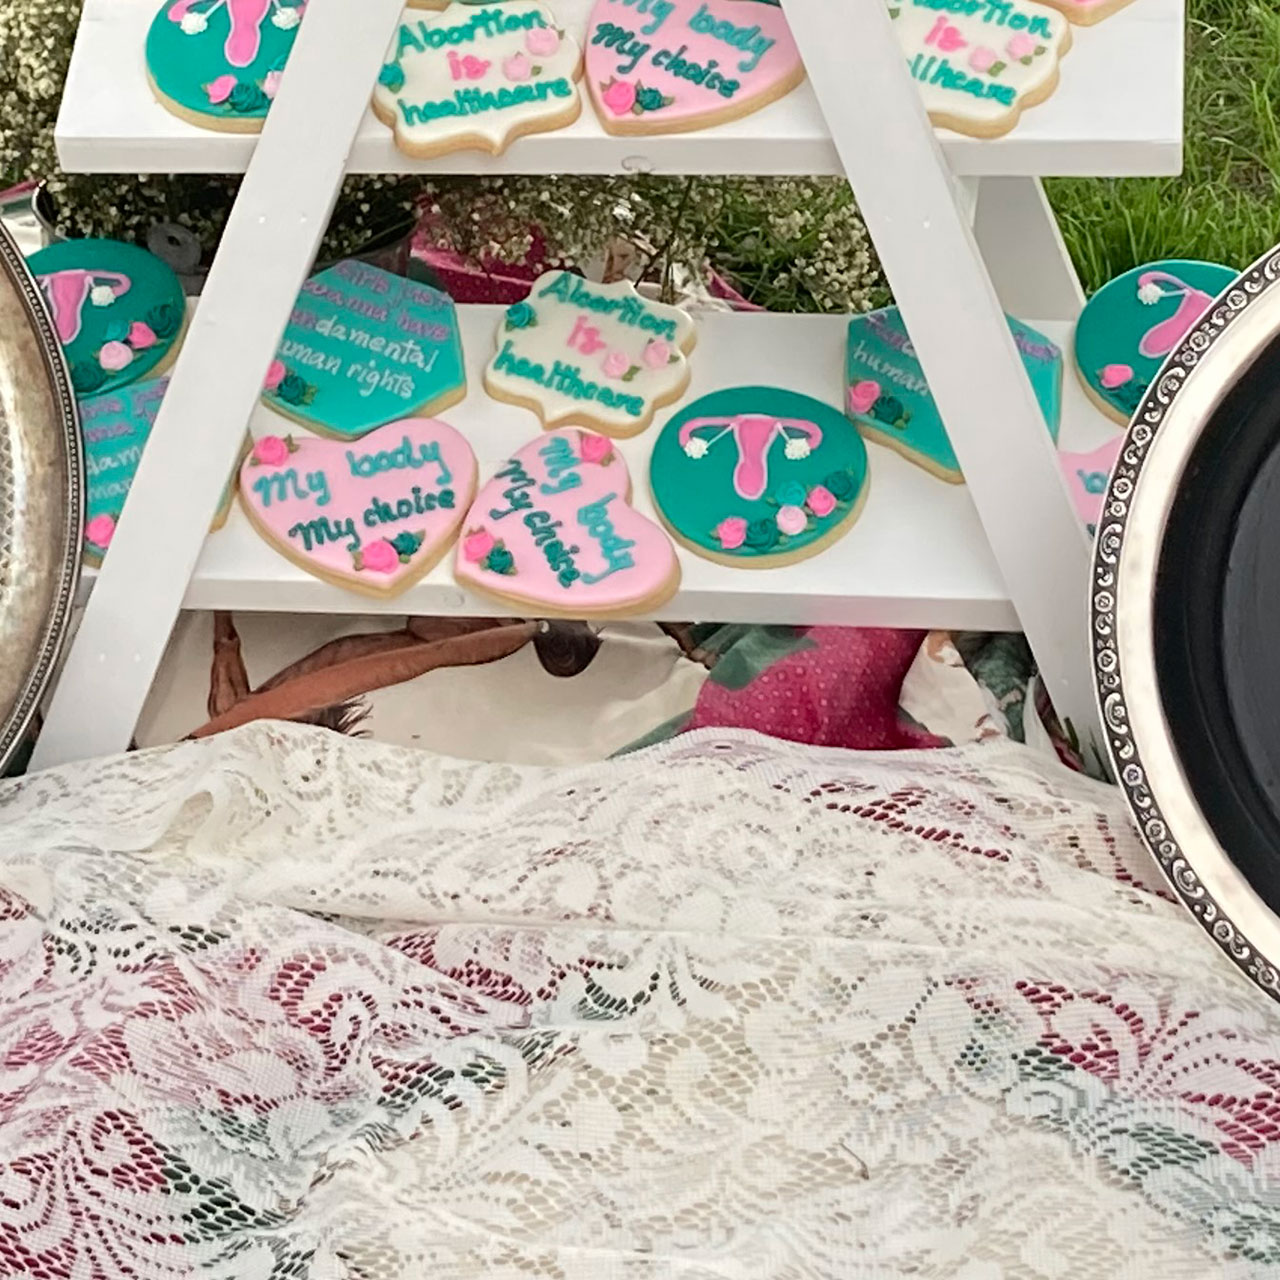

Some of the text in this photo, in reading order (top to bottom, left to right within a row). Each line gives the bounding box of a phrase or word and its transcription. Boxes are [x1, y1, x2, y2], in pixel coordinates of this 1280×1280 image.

[396, 8, 550, 58] Abortion
[446, 50, 491, 81] is
[591, 22, 741, 99] My choice
[688, 2, 776, 73] body
[397, 77, 572, 126] healthcare
[538, 272, 678, 341] Abortion
[347, 359, 416, 399] rights
[494, 339, 645, 416] healthcare
[253, 436, 452, 507] My body
[288, 486, 456, 552] My choice
[489, 459, 580, 588] My choice
[539, 436, 636, 584] My body
